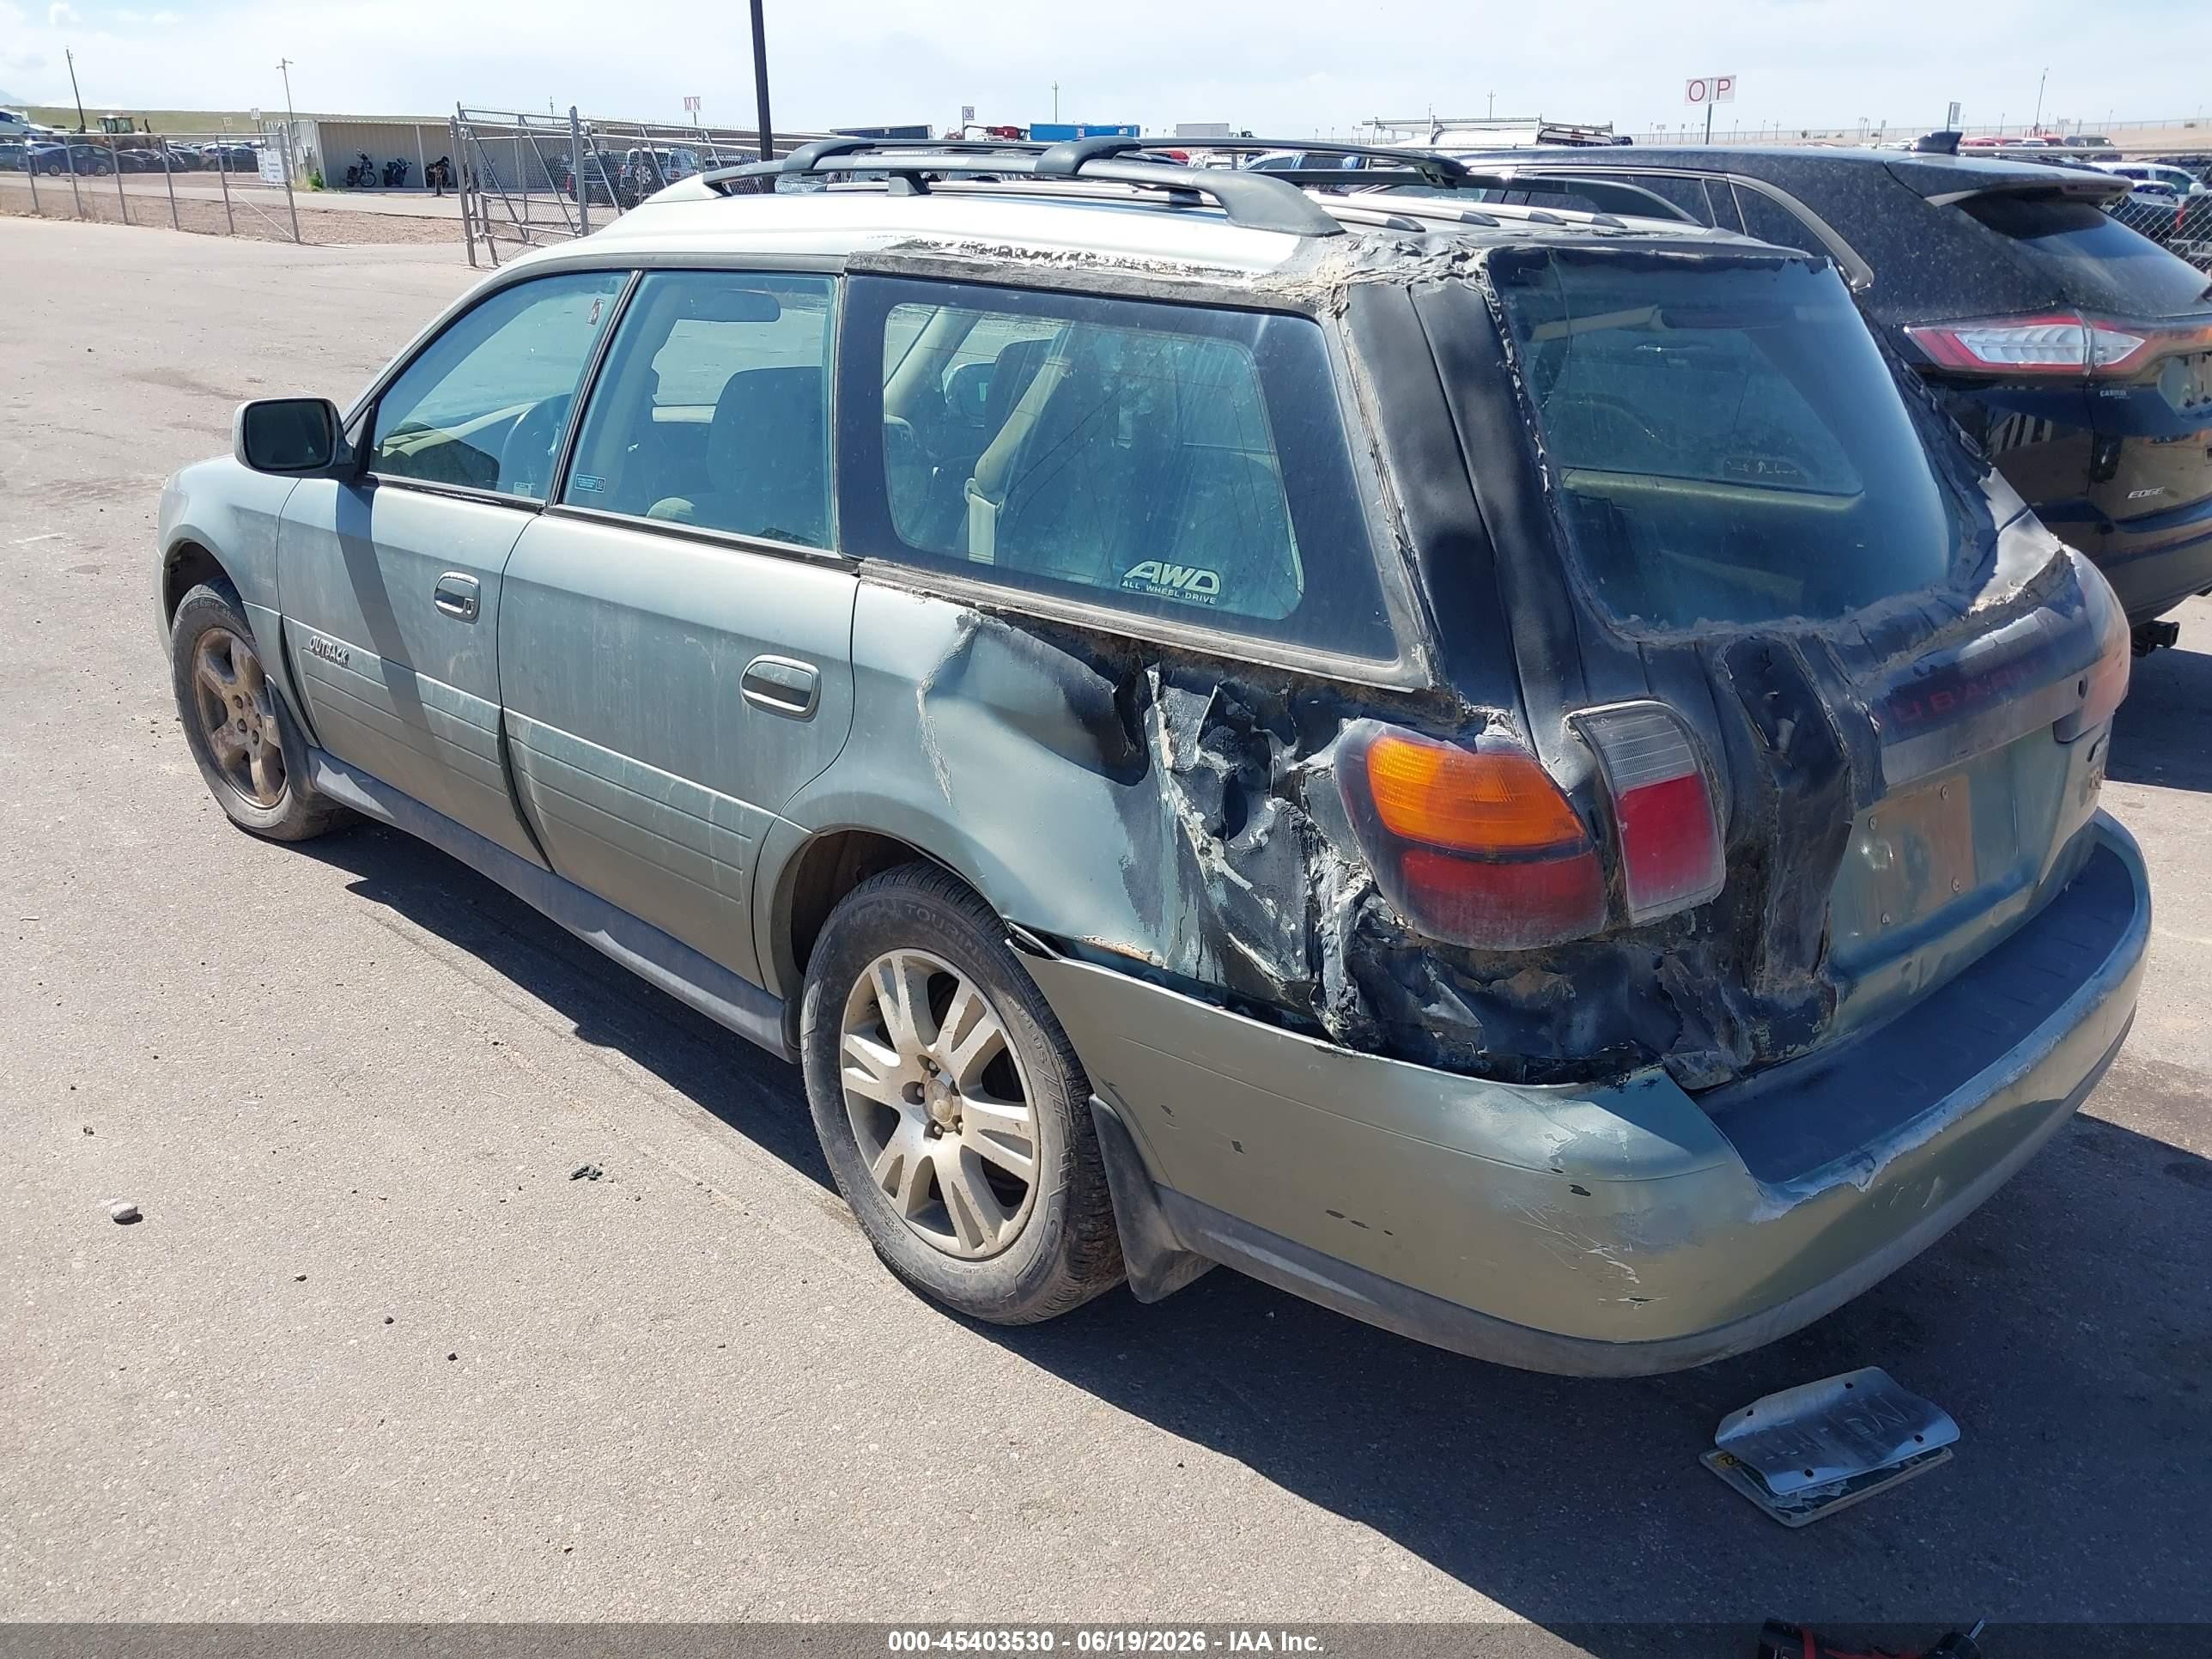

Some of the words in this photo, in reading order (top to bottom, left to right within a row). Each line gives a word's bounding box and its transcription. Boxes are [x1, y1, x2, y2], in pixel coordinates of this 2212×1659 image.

[2128, 486, 2165, 499] EDGE
[1123, 560, 1221, 595] AWD
[1121, 580, 1140, 589] ALL
[1146, 585, 1180, 598] WHEEL
[1184, 592, 1217, 605] DRIVE
[309, 635, 349, 665] OUTBACK
